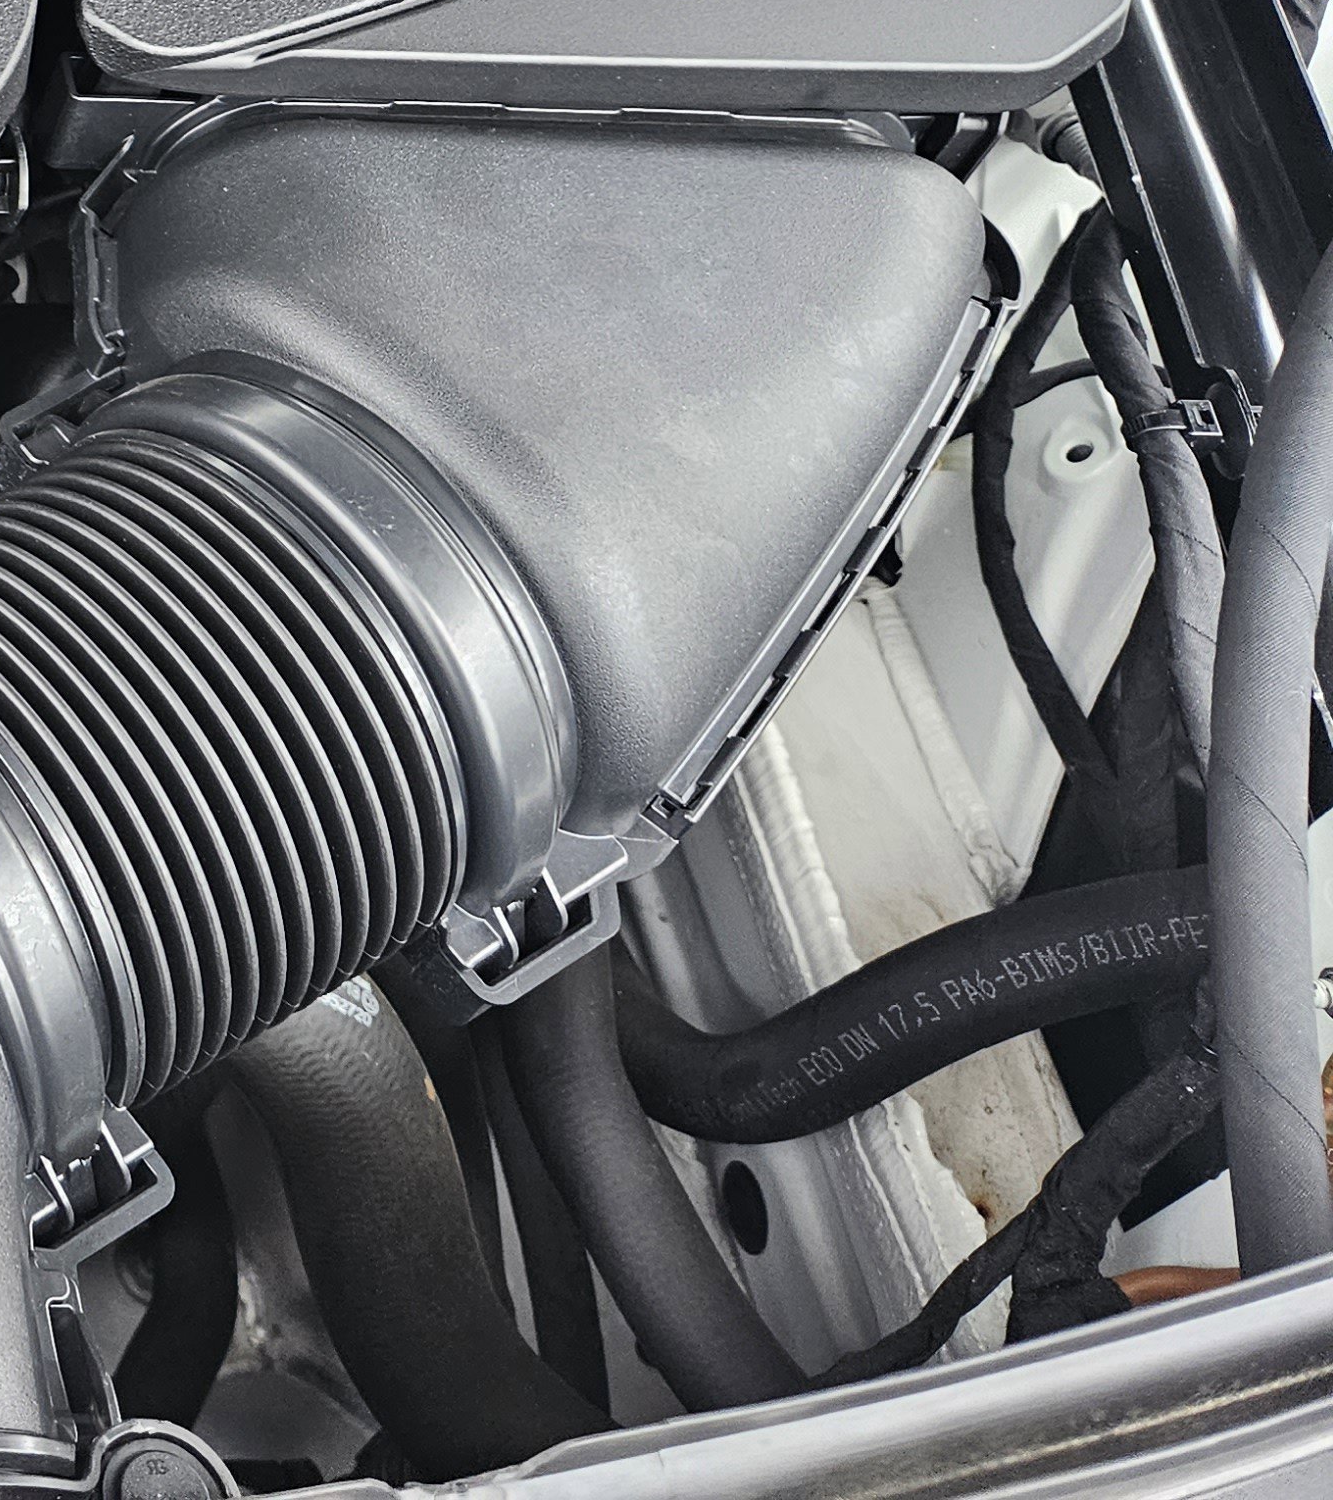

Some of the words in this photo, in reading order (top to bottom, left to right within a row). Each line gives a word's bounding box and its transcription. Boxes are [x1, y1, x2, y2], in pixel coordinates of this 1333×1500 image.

[797, 1046, 844, 1085] ECO
[838, 1023, 880, 1061] DN
[878, 991, 941, 1041] 17,5
[939, 914, 1209, 1010] PA6-BIMS/BIIR-PE
